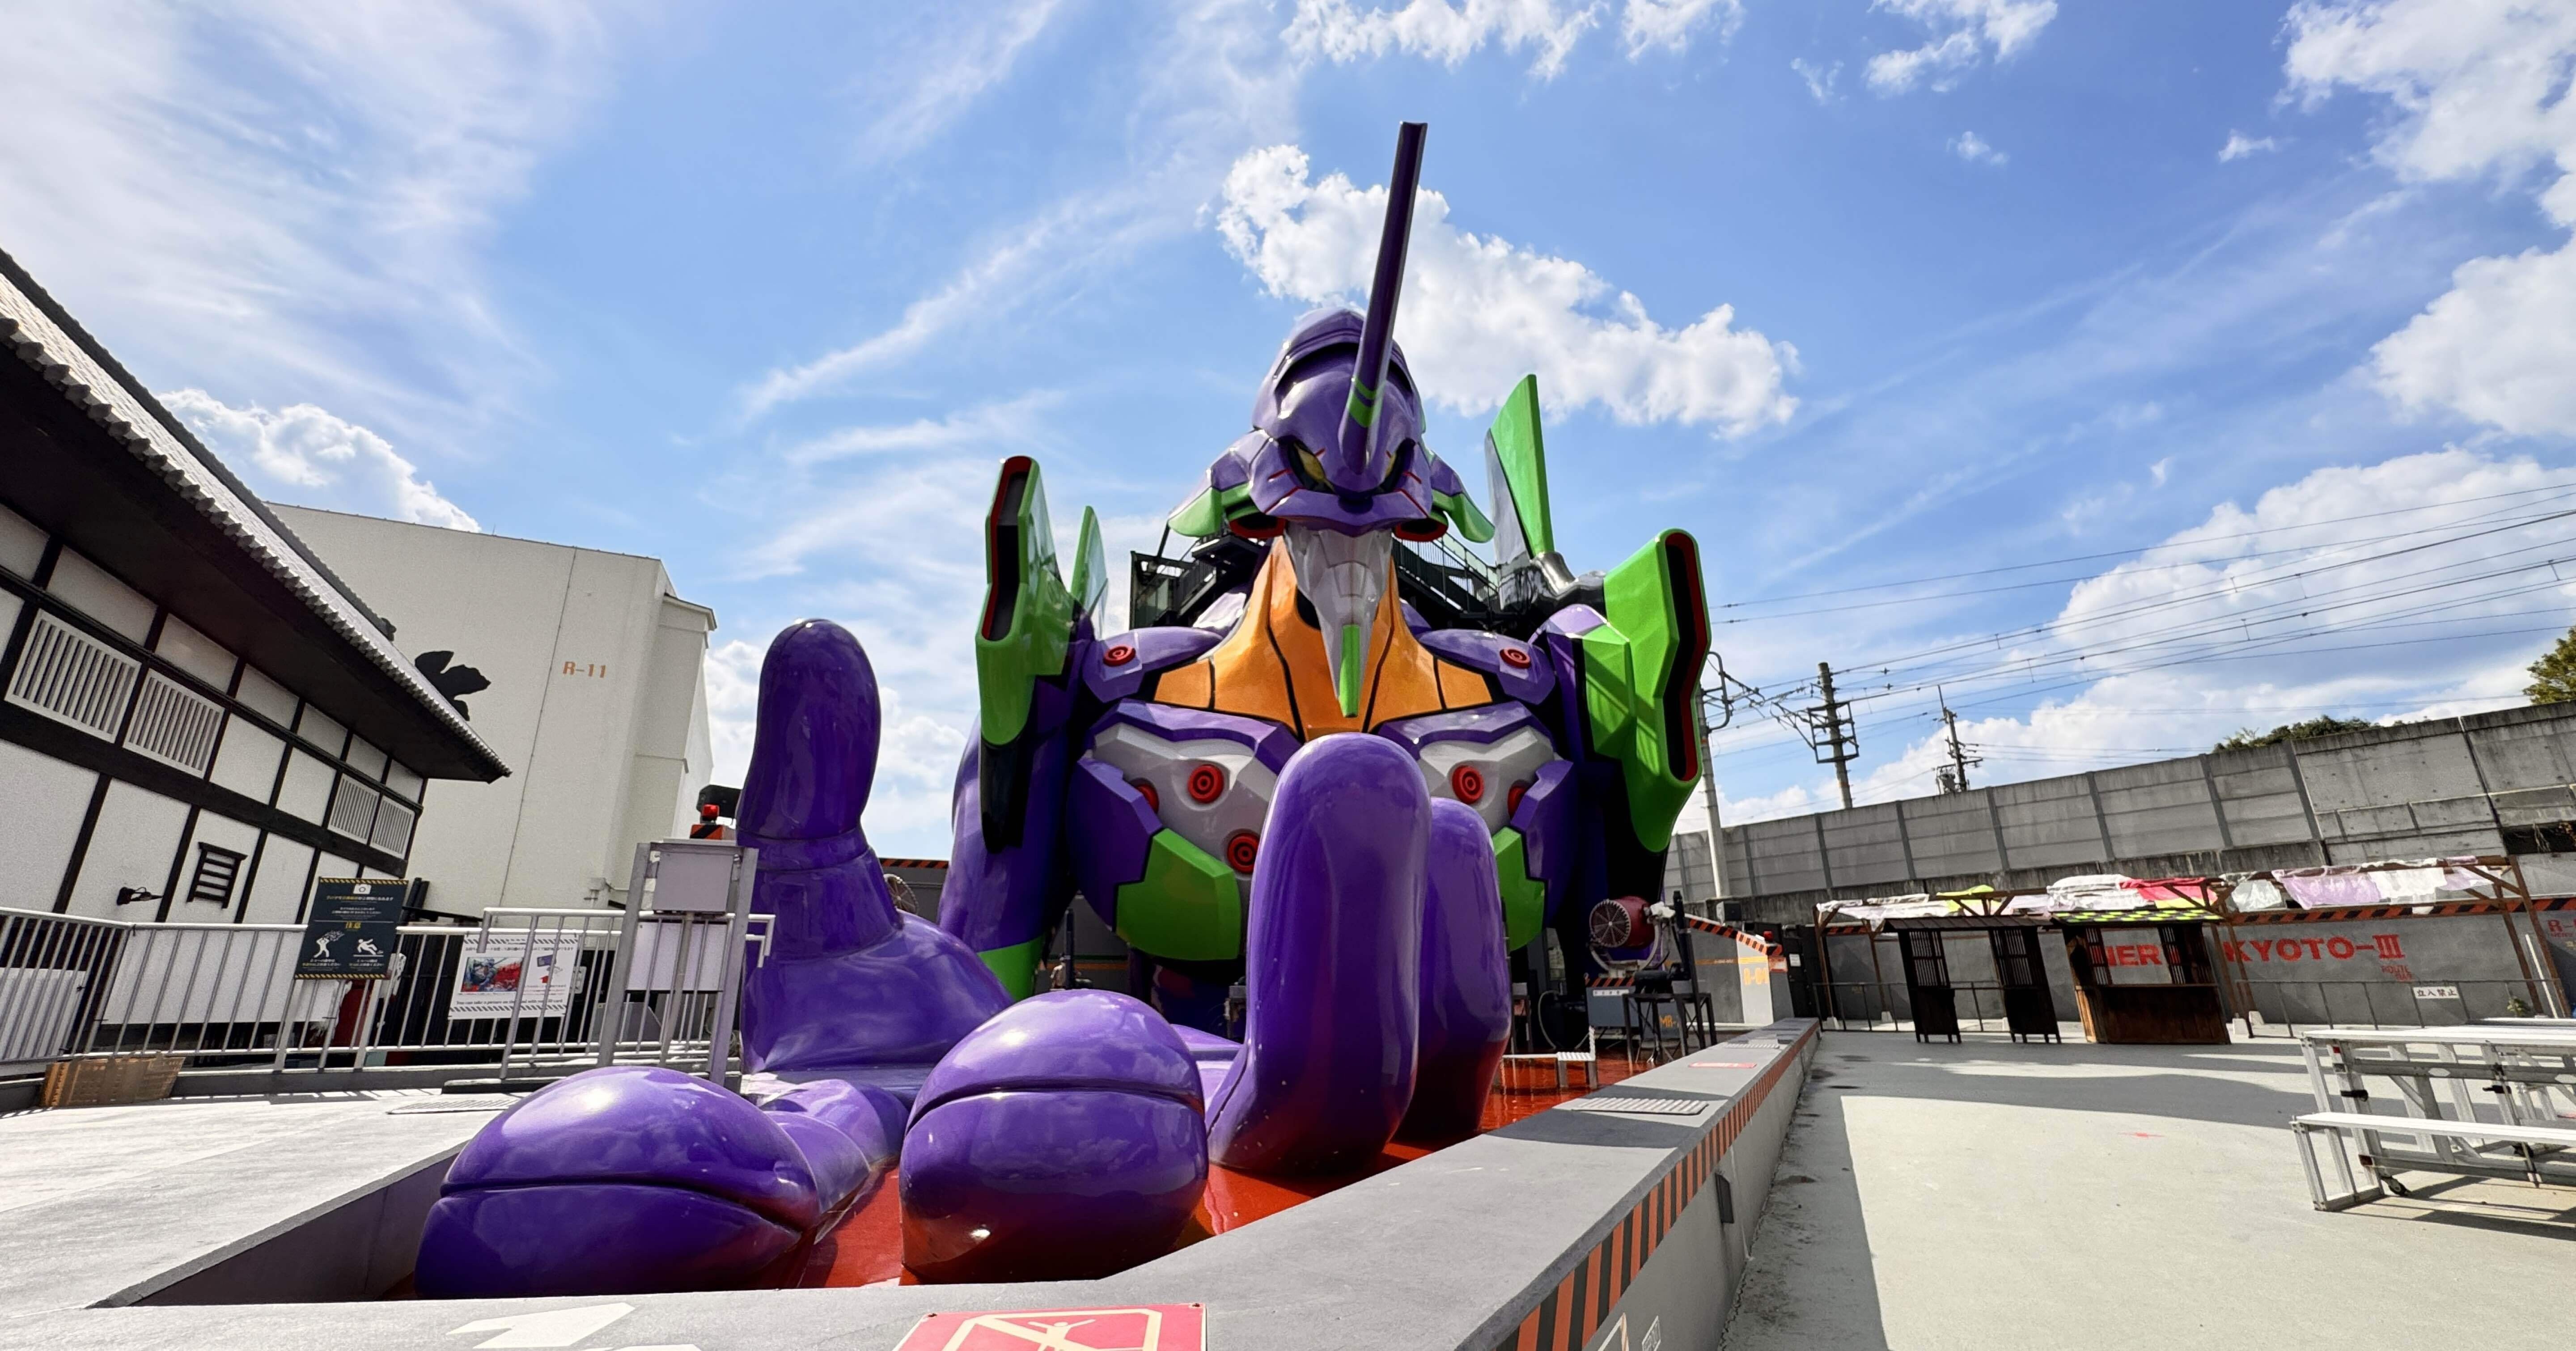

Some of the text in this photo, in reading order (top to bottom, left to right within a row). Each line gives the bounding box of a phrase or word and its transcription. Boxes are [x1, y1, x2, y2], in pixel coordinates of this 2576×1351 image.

[563, 661, 606, 678] R-11
[2547, 919, 2576, 932] R-
[2222, 934, 2406, 962] KYOTO-III
